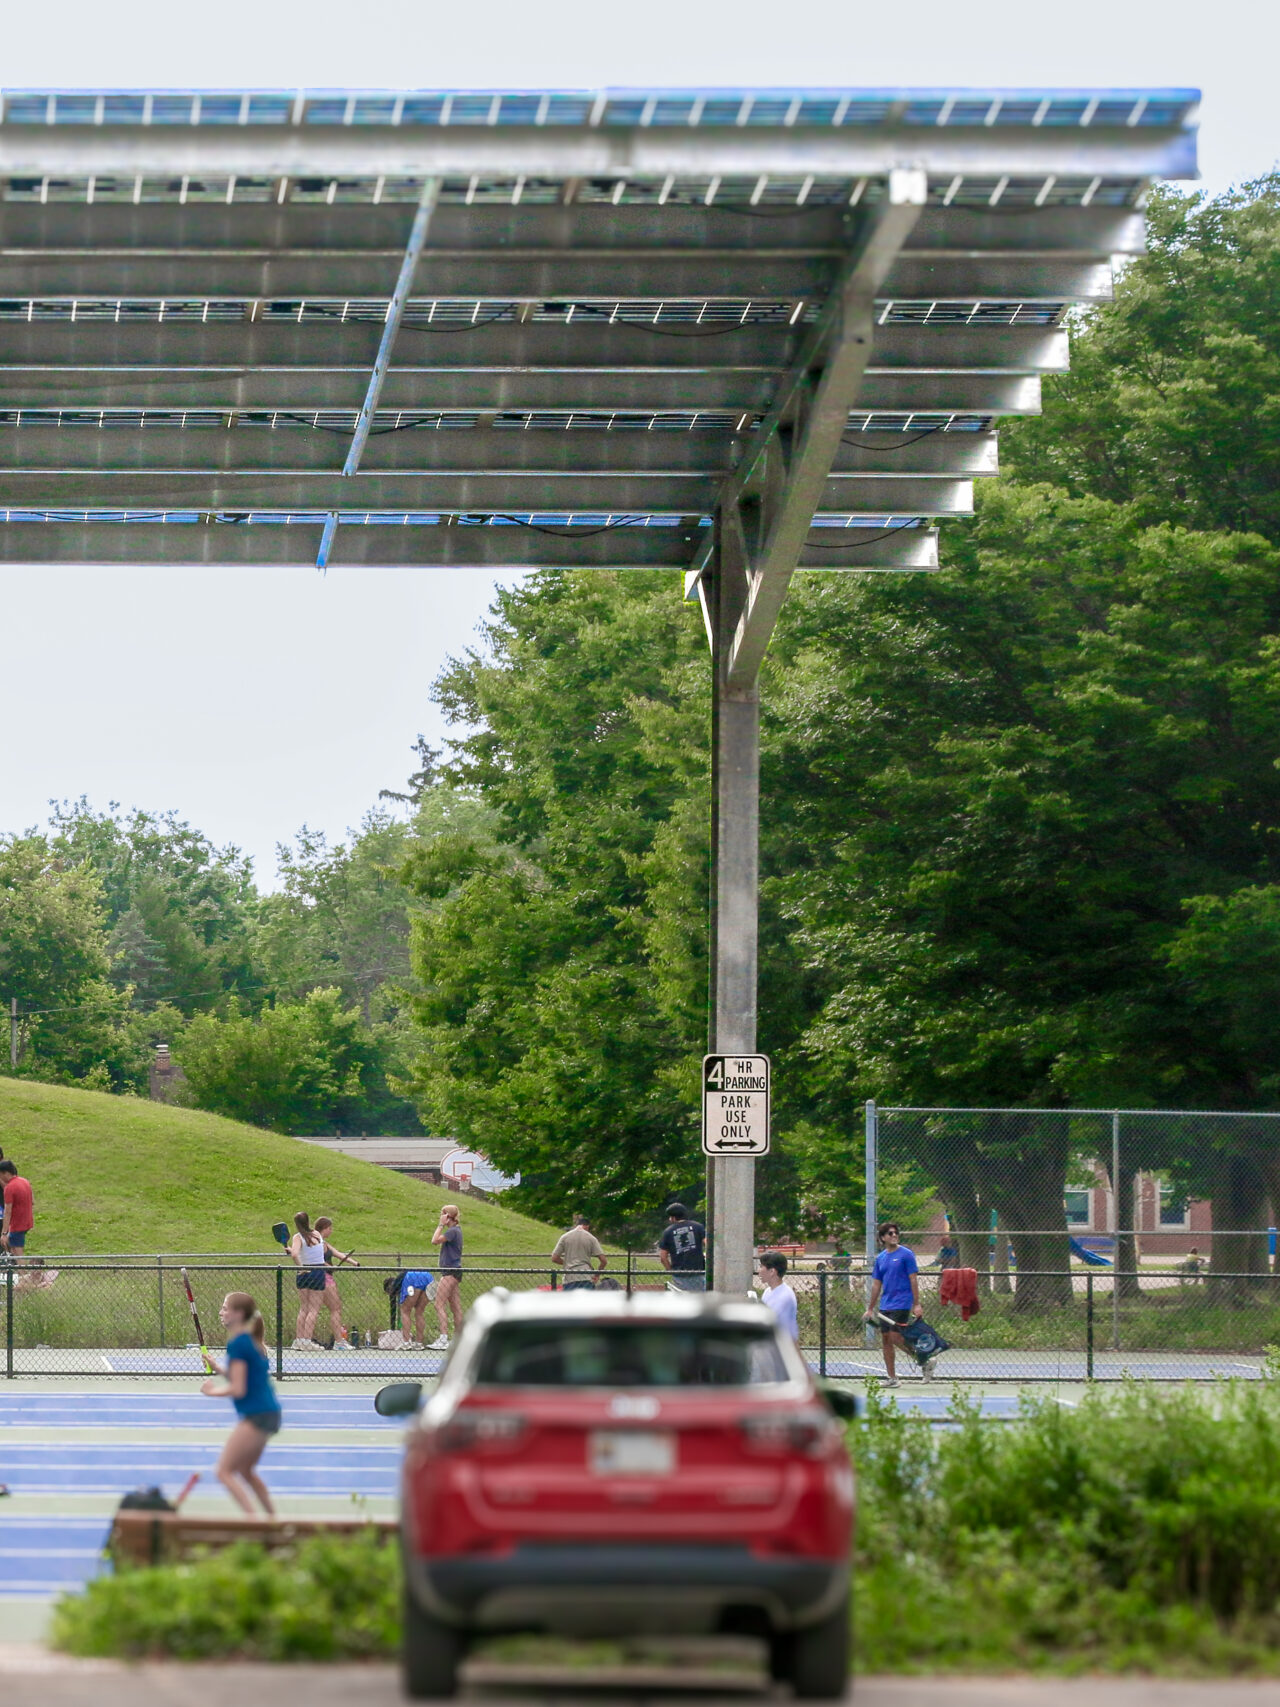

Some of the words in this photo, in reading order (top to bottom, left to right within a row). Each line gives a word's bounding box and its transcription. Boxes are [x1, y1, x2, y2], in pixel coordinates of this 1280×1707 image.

[707, 1061, 724, 1089] 4
[737, 1061, 753, 1073] HR
[725, 1076, 766, 1089] PARKING
[721, 1095, 751, 1108] PARK
[726, 1110, 747, 1123] USE
[721, 1125, 751, 1138] ONLY
